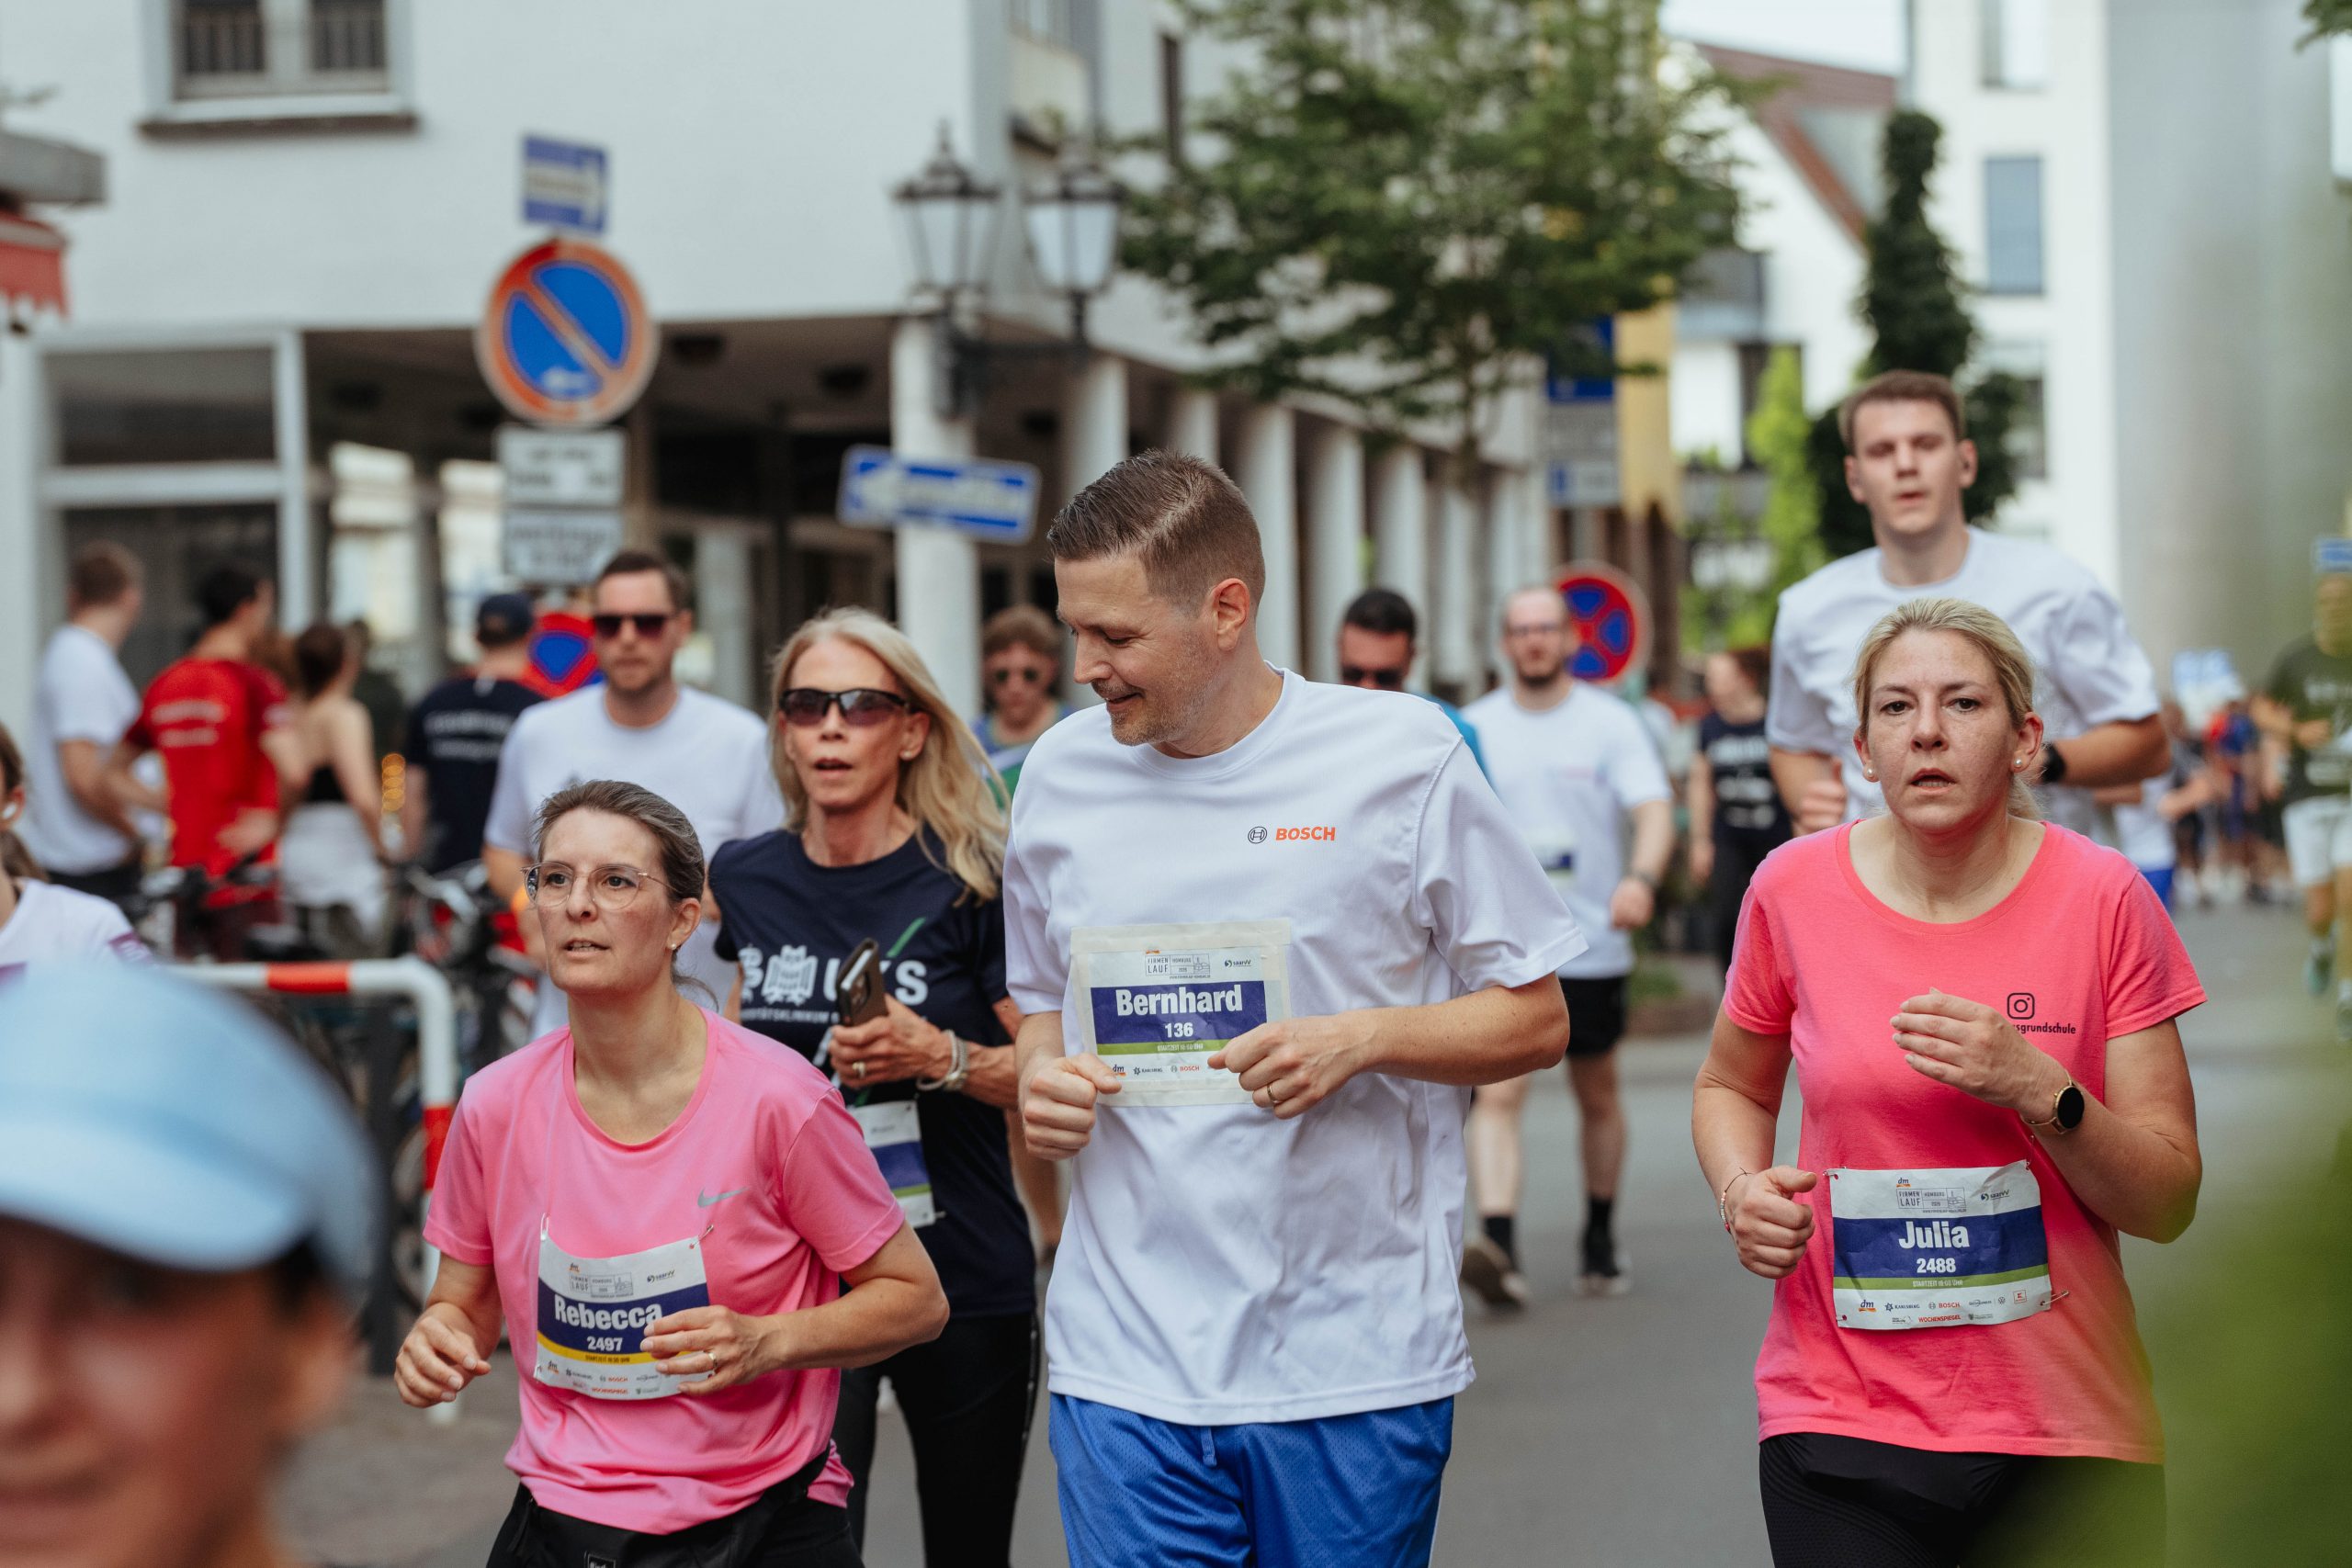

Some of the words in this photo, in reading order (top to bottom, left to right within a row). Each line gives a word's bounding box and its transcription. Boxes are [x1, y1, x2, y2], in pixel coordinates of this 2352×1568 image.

[1275, 826, 1336, 840] BOSCH
[1148, 964, 1169, 974] LAUF
[1115, 985, 1243, 1017] Bernhard
[1164, 1022, 1193, 1038] 136
[2014, 1021, 2076, 1034] sgrundschule
[1113, 1064, 1125, 1073] dm
[1900, 1198, 1921, 1207] LAUF
[1898, 1221, 1971, 1249] Julia
[1916, 1258, 1957, 1273] 2488
[1860, 1299, 1874, 1308] dm
[554, 1294, 662, 1330] Rebecca
[1918, 1314, 1962, 1323] WOCHENSPIEGEL
[586, 1336, 624, 1352] 2497
